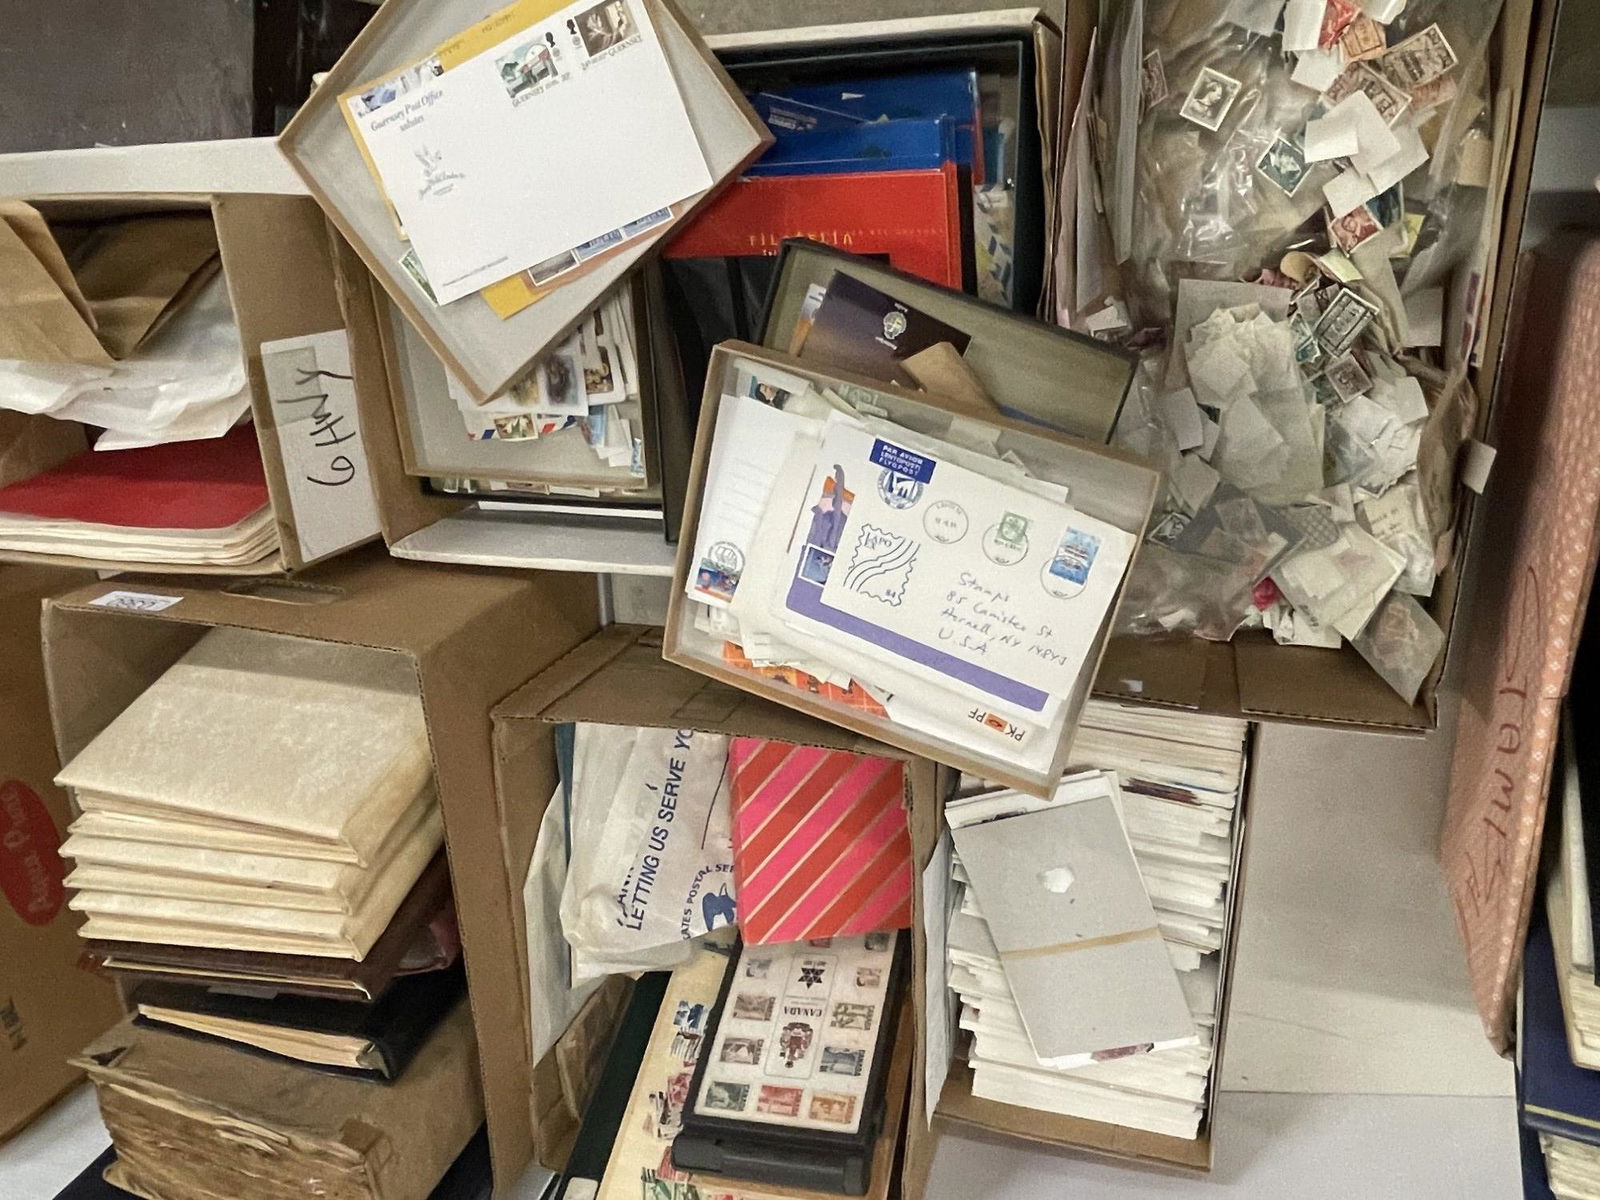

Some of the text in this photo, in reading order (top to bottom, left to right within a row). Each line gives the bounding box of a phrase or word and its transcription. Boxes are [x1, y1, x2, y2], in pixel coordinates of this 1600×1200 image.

[421, 90, 443, 106] Office
[882, 444, 924, 465] PAR AVION
[945, 590, 969, 605] 85
[999, 634, 1022, 647] NY
[967, 707, 1026, 742] PK PF
[673, 728, 696, 751] YO
[657, 757, 687, 824] SERVE
[648, 825, 670, 852] US
[626, 855, 660, 930] LETTING
[685, 862, 714, 906] POSTAL
[783, 1005, 823, 1018] CANADA
